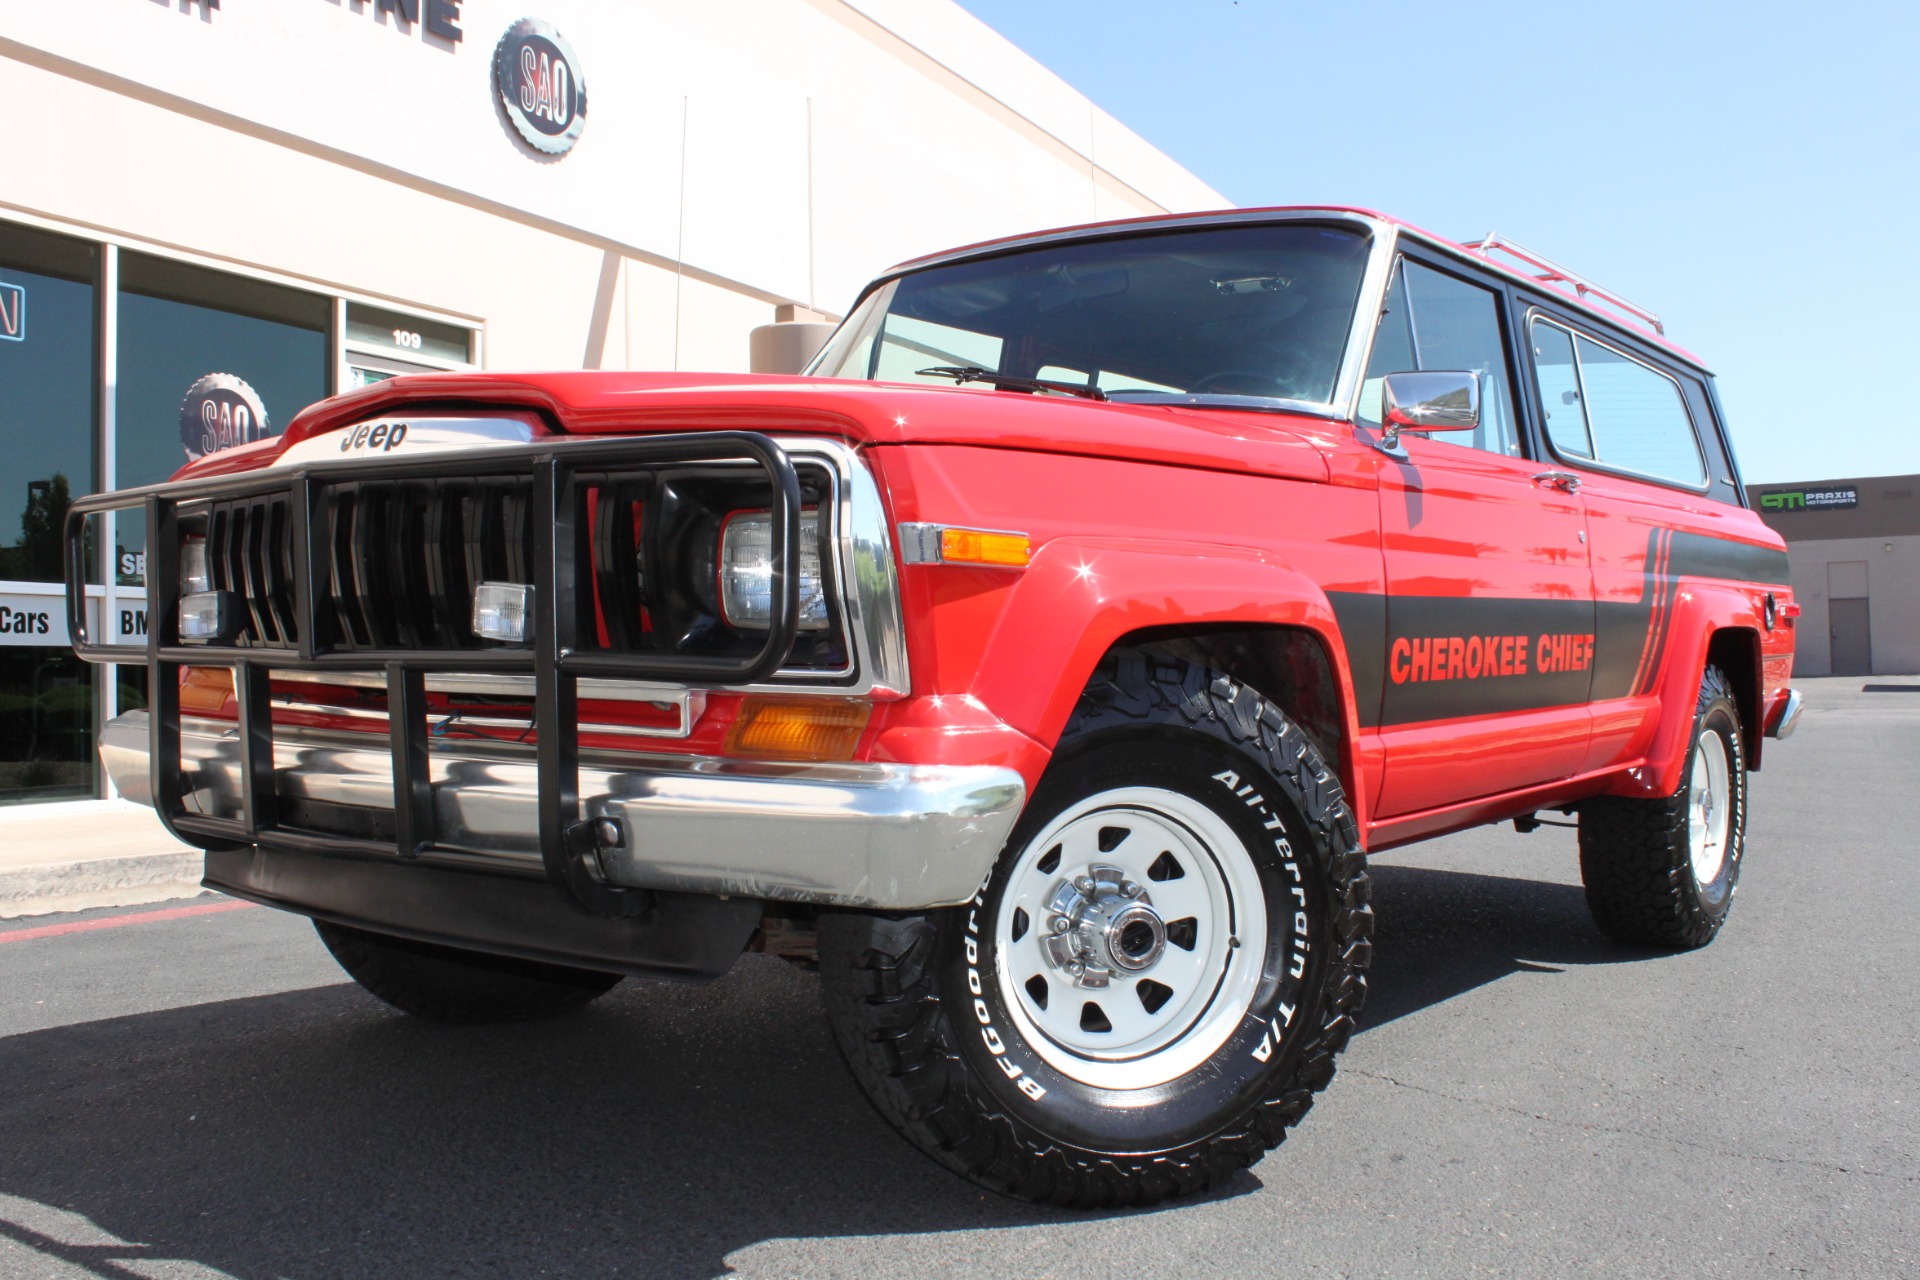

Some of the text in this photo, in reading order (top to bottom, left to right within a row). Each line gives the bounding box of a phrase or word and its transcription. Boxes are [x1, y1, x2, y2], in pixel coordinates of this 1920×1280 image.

[520, 45, 568, 126] SAO
[393, 330, 421, 348] 109
[340, 422, 408, 452] Jeep
[1805, 490, 1856, 501] PRAXIS
[0, 606, 49, 634] Cars
[1390, 633, 1595, 685] CHEROKEE CHIEF
[1212, 769, 1310, 979] All-Terrain
[1252, 1002, 1296, 1063] T/A
